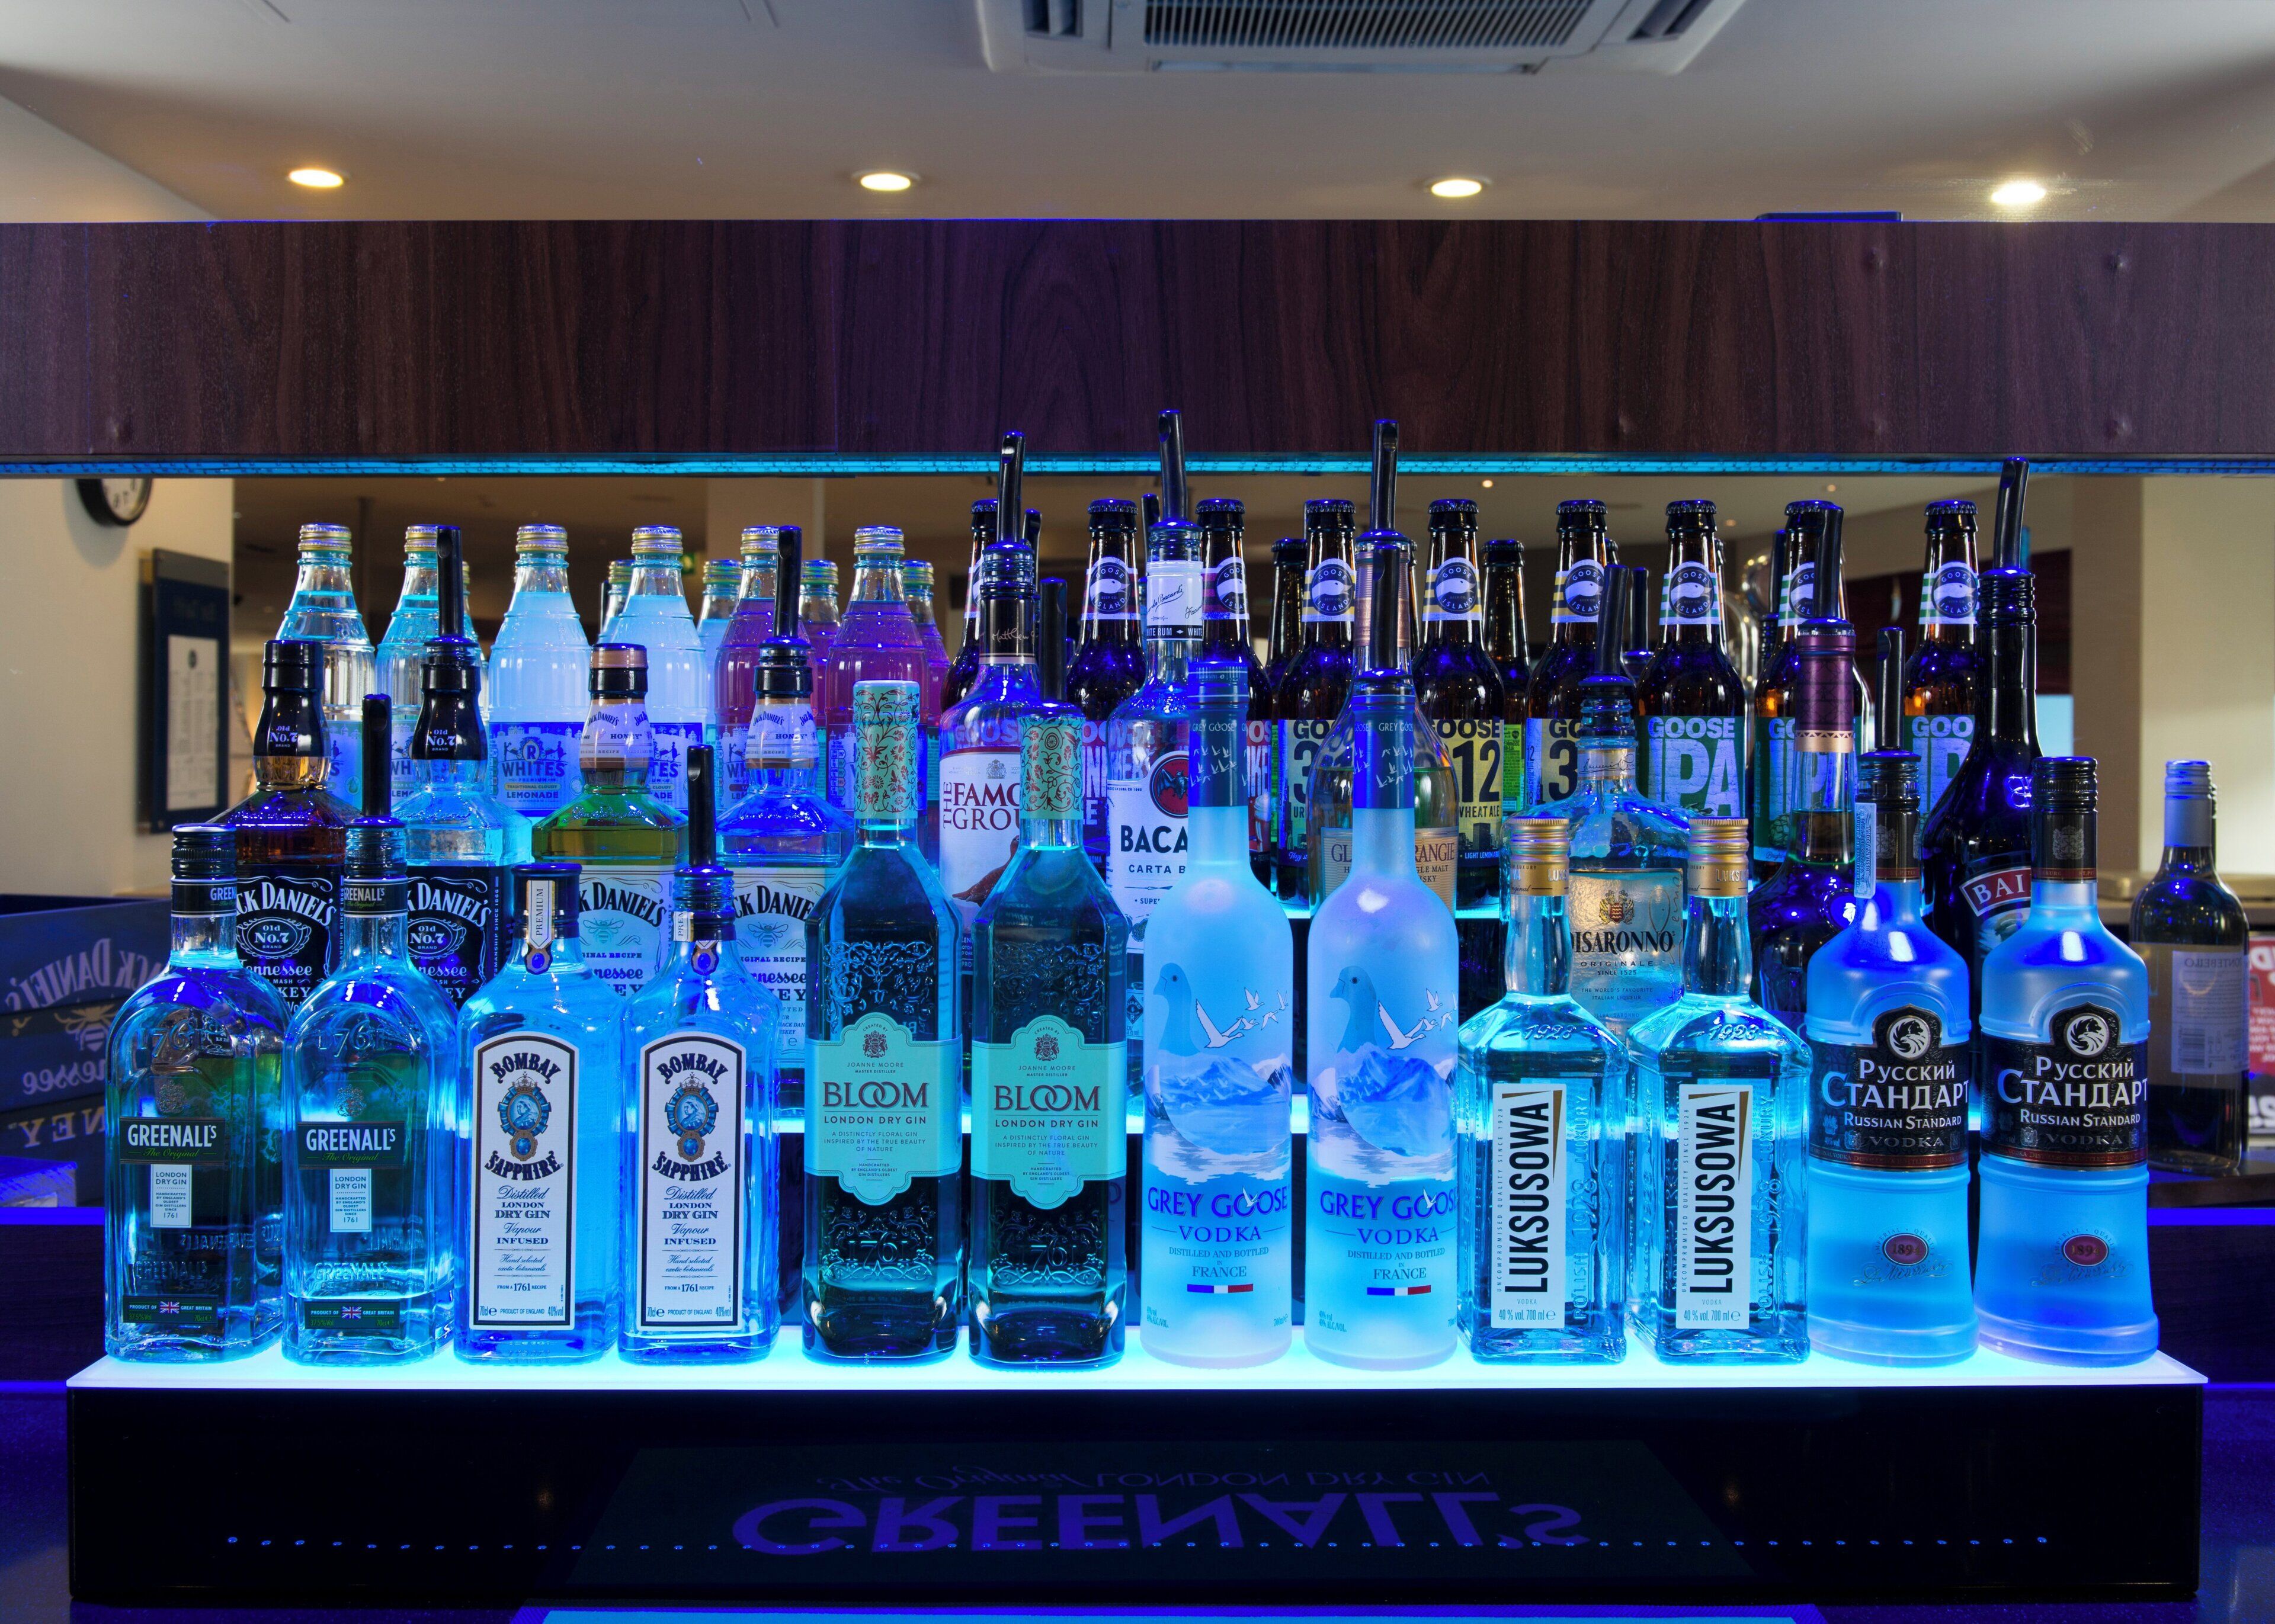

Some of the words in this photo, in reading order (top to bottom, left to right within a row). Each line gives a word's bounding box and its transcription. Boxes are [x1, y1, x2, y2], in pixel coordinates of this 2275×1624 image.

[1095, 567, 1124, 579] GOOSE
[1318, 569, 1347, 580] GOOSE
[1442, 567, 1472, 579] GOOSE
[1677, 572, 1707, 583] GOOSE
[1940, 572, 1972, 583] GOOSE
[1094, 597, 1126, 609] ISLAND
[1317, 599, 1348, 611] ISLAND
[1442, 597, 1473, 609] ISLAND
[1675, 602, 1709, 614] ISLAND
[1938, 602, 1974, 614] ISLAND
[1158, 628, 1172, 636] RUM
[1188, 628, 1203, 636] WHITE
[588, 713, 597, 726] JACK
[598, 711, 619, 726] DANIEL'S
[753, 713, 762, 726] JACK
[763, 711, 784, 726] DANIEL'S
[1648, 717, 1735, 738] GOOSE
[269, 732, 298, 742] No.7
[426, 736, 456, 746] No.7
[527, 746, 536, 759] R
[502, 762, 565, 777] WHITES
[1453, 740, 1500, 803] 12
[1649, 739, 1740, 817] IPA
[953, 782, 1020, 806] FAMO
[943, 782, 952, 828] THE
[1489, 805, 1499, 817] ALE
[1120, 825, 1188, 853] BACA
[1129, 865, 1171, 874] CARTA
[261, 882, 337, 926] DANIEL'S
[417, 882, 492, 927] DANIEL'S
[593, 882, 667, 927] DANIEL'S
[536, 888, 544, 936] PREMIUM
[254, 932, 289, 943] No.7
[409, 933, 444, 944] No.7
[489, 1052, 561, 1084] BOMBAY
[656, 1053, 728, 1084] BOMBAY
[822, 1081, 930, 1108] BLOOM
[994, 1084, 1101, 1112] BLOOM
[824, 1116, 873, 1124] LONDON
[879, 1116, 902, 1124] DRY
[906, 1116, 926, 1124] GIN
[995, 1119, 1045, 1128] LONDON
[1050, 1119, 1073, 1128] DRY
[127, 1124, 217, 1147] GREENALL'S
[306, 1128, 396, 1151] GREENALL'S
[1869, 1137, 1944, 1148] VODKA
[2046, 1134, 2123, 1144] VODKA
[143, 1148, 161, 1157] The
[163, 1148, 200, 1160] Original
[484, 1150, 561, 1181] SAPPHIRE
[652, 1151, 729, 1182] SAPPHIRE
[496, 1185, 550, 1199] Distilled
[664, 1186, 717, 1200] Distilled
[1504, 1102, 1550, 1292] LUKSUSOWA
[1690, 1103, 1735, 1293] LUKSUSOWA
[1148, 1187, 1204, 1217] GREY
[1211, 1186, 1288, 1218] GOOSE
[1321, 1190, 1385, 1220] GREY
[495, 1210, 524, 1218] DRY
[504, 1222, 541, 1236] Vapour
[671, 1223, 709, 1237] Vapour
[1179, 1225, 1263, 1243] VODKA
[1357, 1227, 1440, 1244] VODKA
[499, 1254, 520, 1263] Hand
[1169, 1247, 1210, 1258] DISTILLED
[1234, 1246, 1269, 1258] BOTTLED
[1192, 1266, 1247, 1278] FRANCE
[1373, 1267, 1427, 1280] FRANCE
